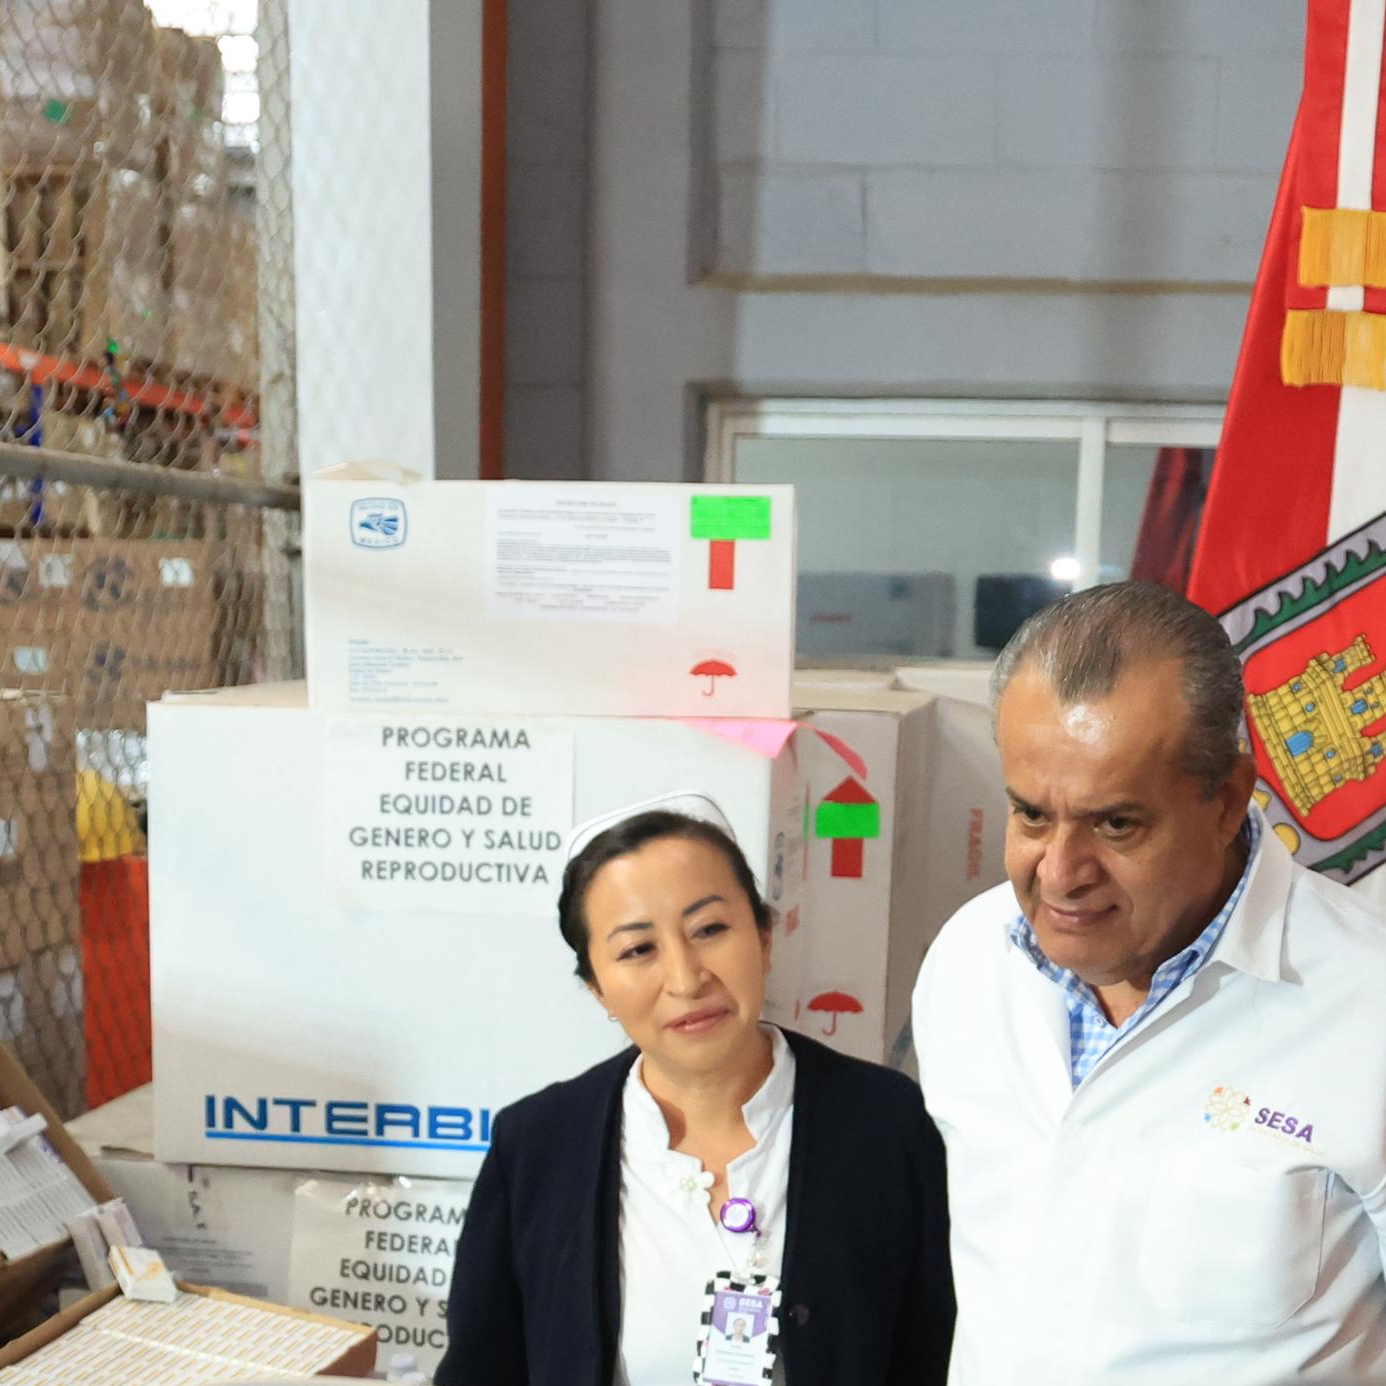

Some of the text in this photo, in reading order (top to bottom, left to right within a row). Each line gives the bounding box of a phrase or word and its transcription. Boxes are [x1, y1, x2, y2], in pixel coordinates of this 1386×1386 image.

[381, 726, 532, 751] PROGRAMA
[404, 762, 508, 784] FEDERAL
[379, 795, 533, 819] EQUIDAD DE
[348, 826, 563, 853] GENERO Y SALUD
[360, 859, 550, 886] REPRODUCTIVA
[205, 1095, 493, 1143] INTERBI
[1254, 1107, 1315, 1143] SESA
[344, 1198, 467, 1226] PROGRAM
[365, 1230, 451, 1256] FEDERA
[339, 1258, 447, 1287] EQUIDAD
[309, 1287, 406, 1315] GENERO
[415, 1298, 430, 1317] Y
